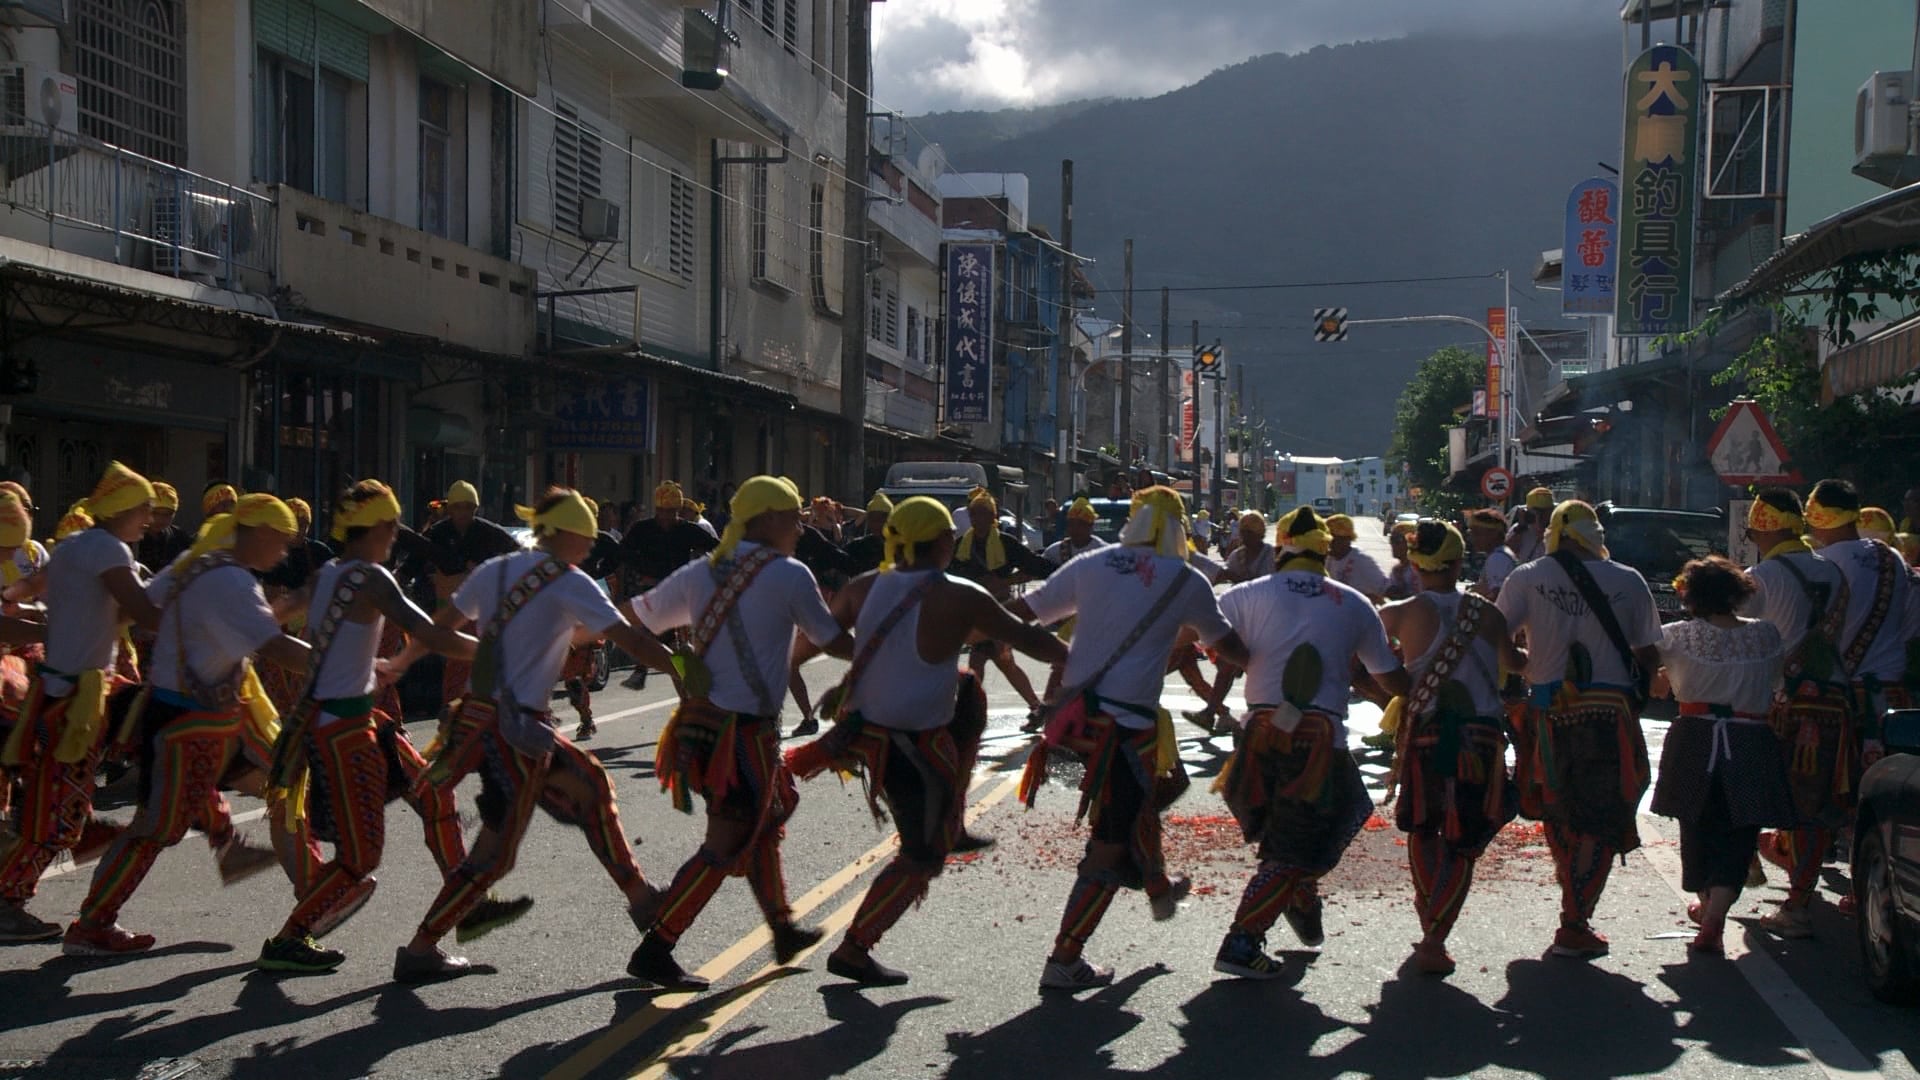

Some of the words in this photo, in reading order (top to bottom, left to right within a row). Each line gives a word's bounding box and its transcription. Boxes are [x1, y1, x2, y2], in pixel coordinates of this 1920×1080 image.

[1577, 188, 1615, 266] 馥蕾
[1629, 60, 1691, 321] 大順釣具行
